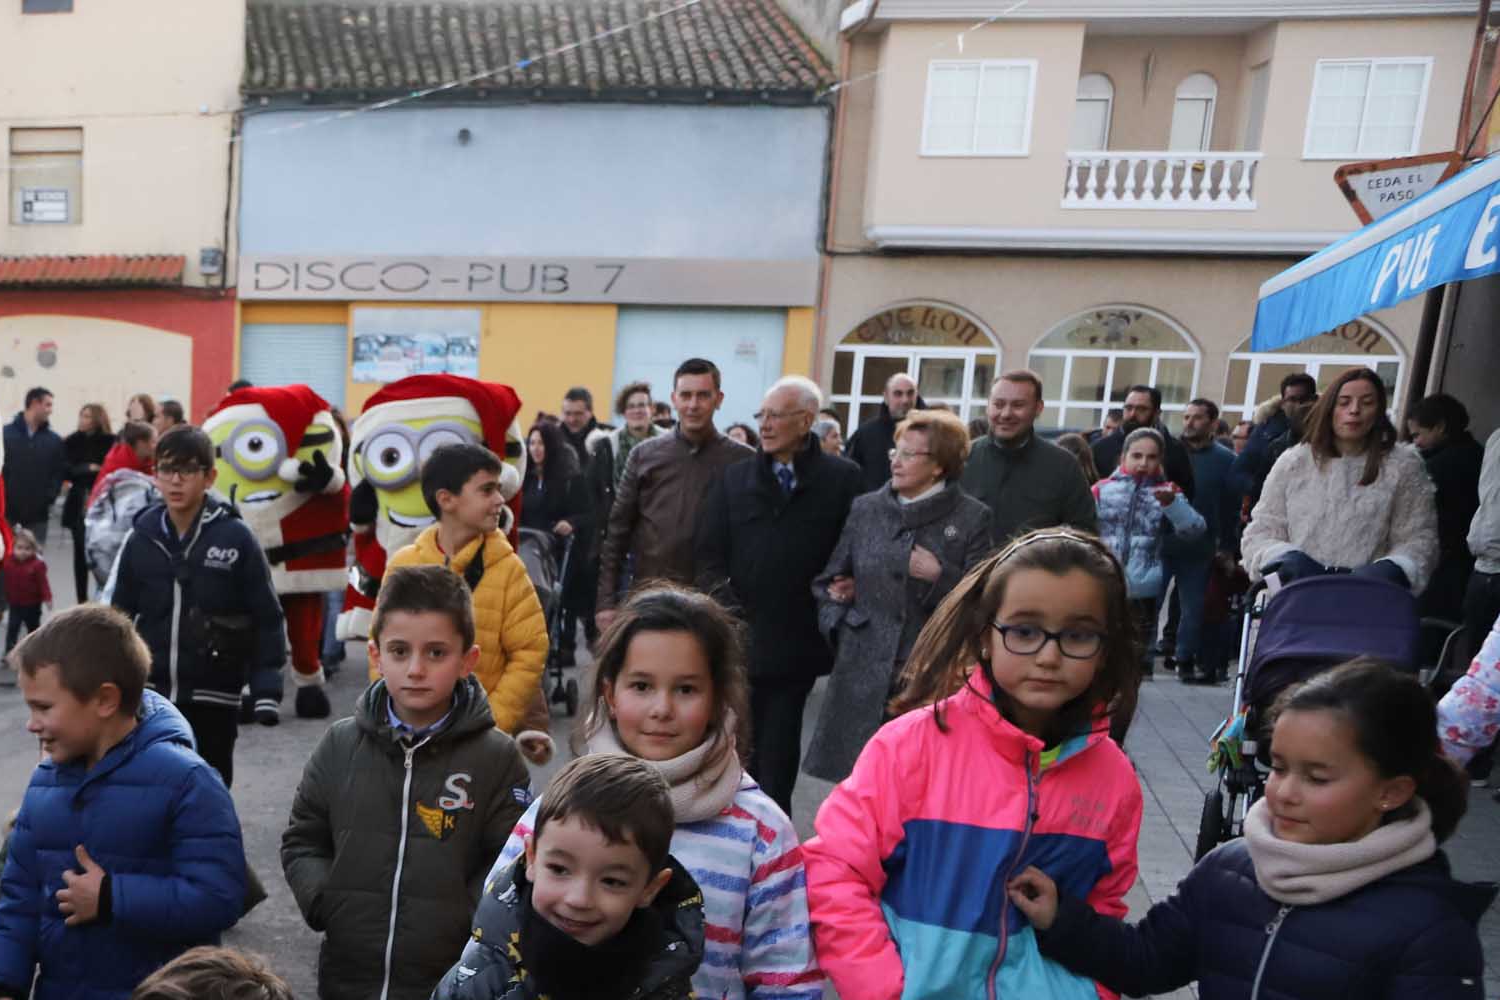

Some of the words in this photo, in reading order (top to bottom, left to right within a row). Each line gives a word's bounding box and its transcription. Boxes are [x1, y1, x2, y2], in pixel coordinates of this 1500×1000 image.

[1367, 175, 1402, 190] CEDA
[1407, 174, 1423, 184] EL
[1379, 190, 1414, 203] PASO
[1370, 223, 1443, 305] PUB
[254, 262, 570, 293] DISCO-PUB
[595, 264, 625, 293] 7
